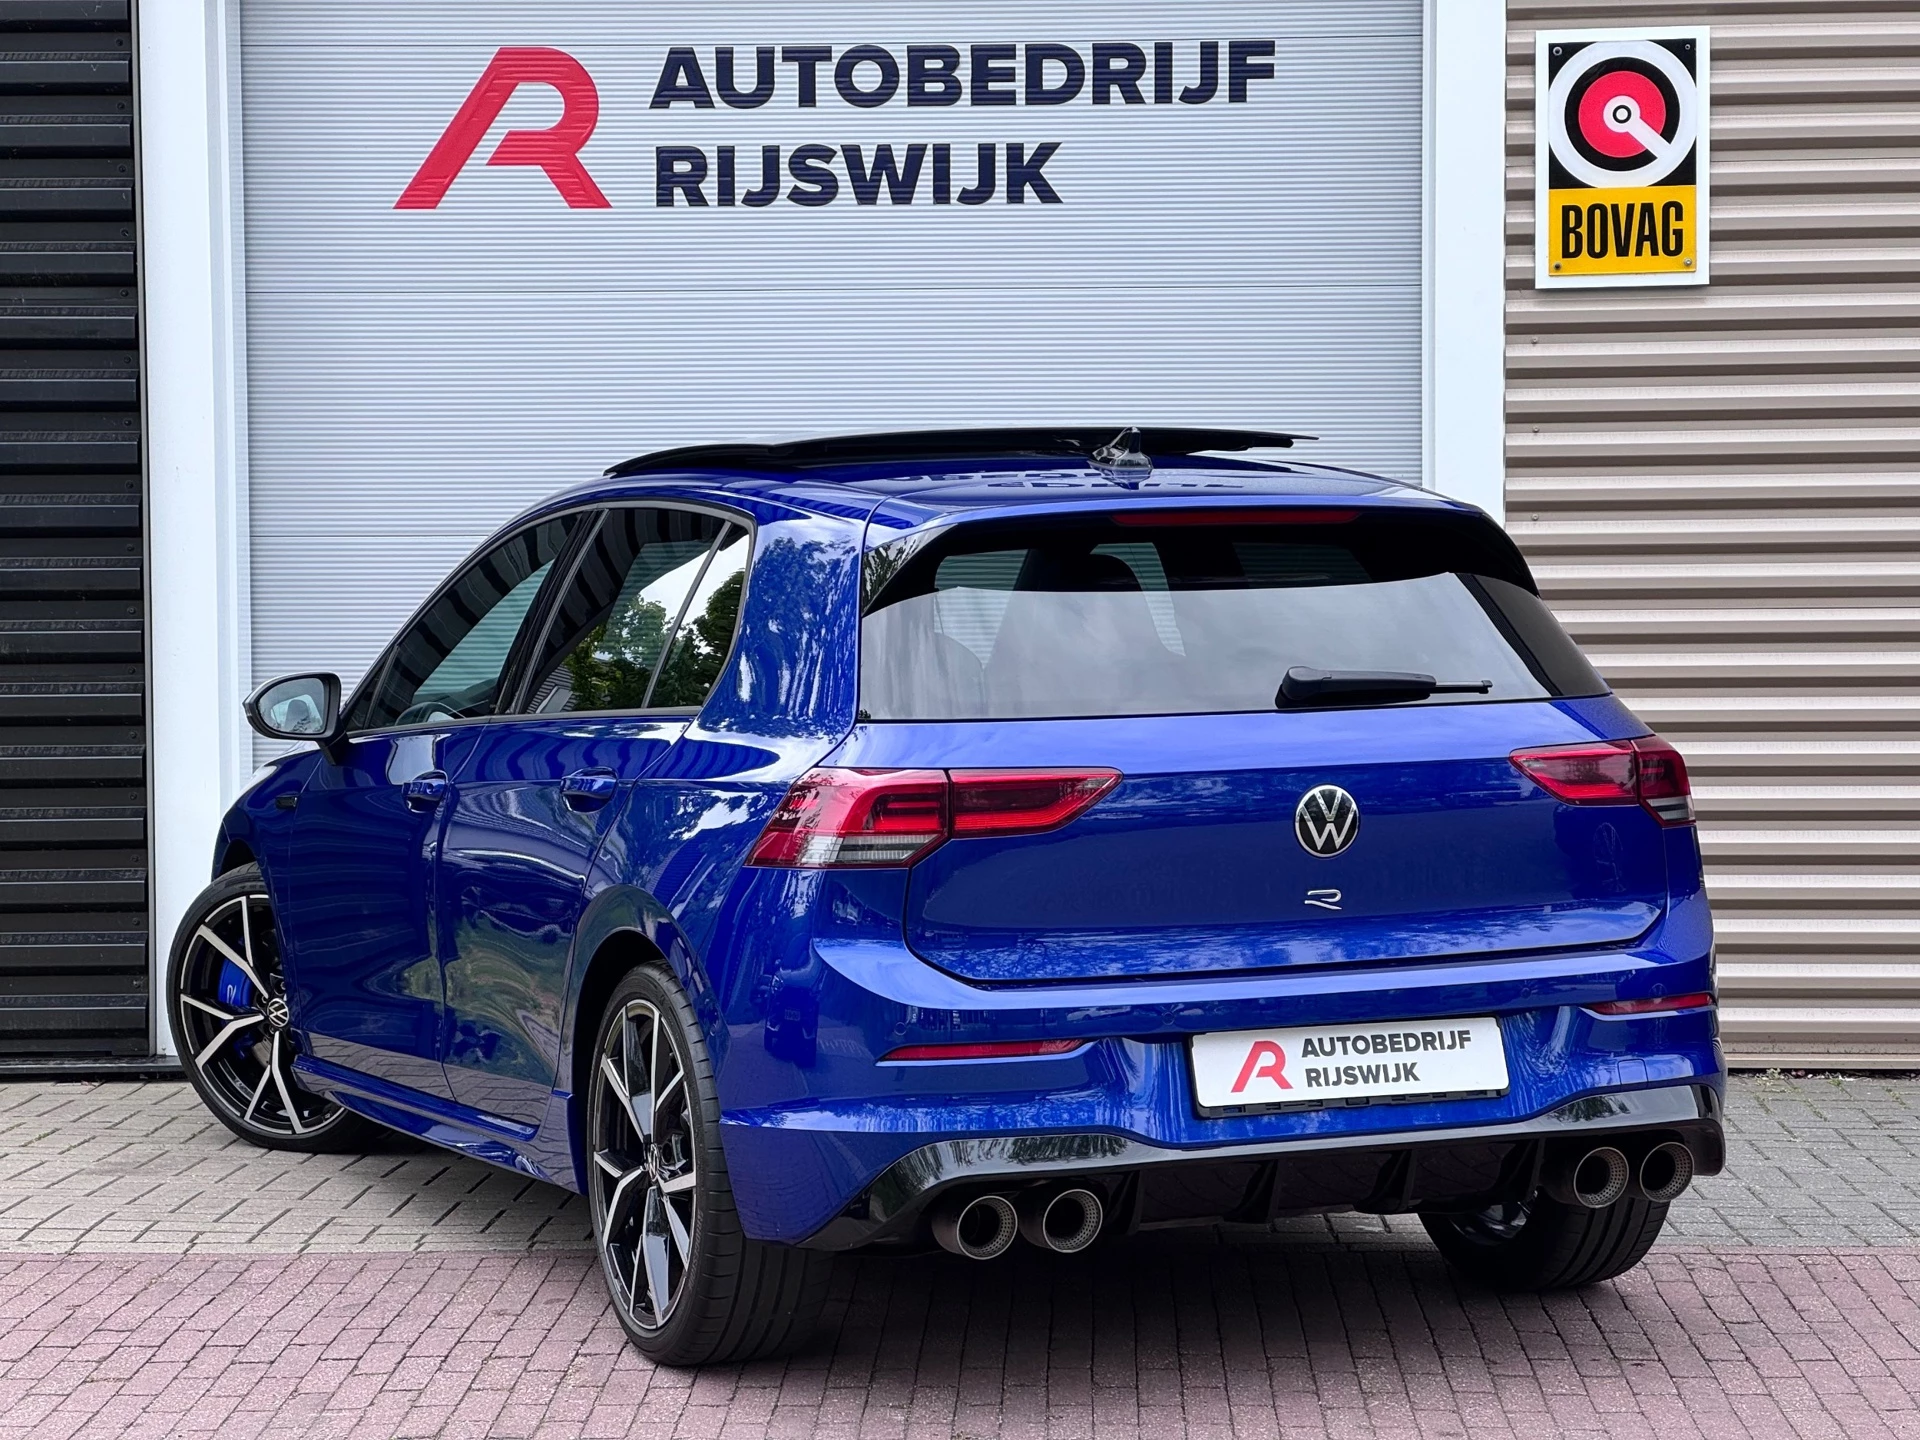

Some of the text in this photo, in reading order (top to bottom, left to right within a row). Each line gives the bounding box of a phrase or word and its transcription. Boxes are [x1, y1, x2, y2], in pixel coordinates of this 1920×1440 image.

[649, 40, 1276, 110] AUTOBEDRIJF
[655, 142, 1063, 207] RIJSWIJK
[1561, 200, 1684, 260] BOVAG
[1301, 1029, 1471, 1059] AUTOBEDRIJF
[1304, 1062, 1421, 1089] RIJSWIJK
